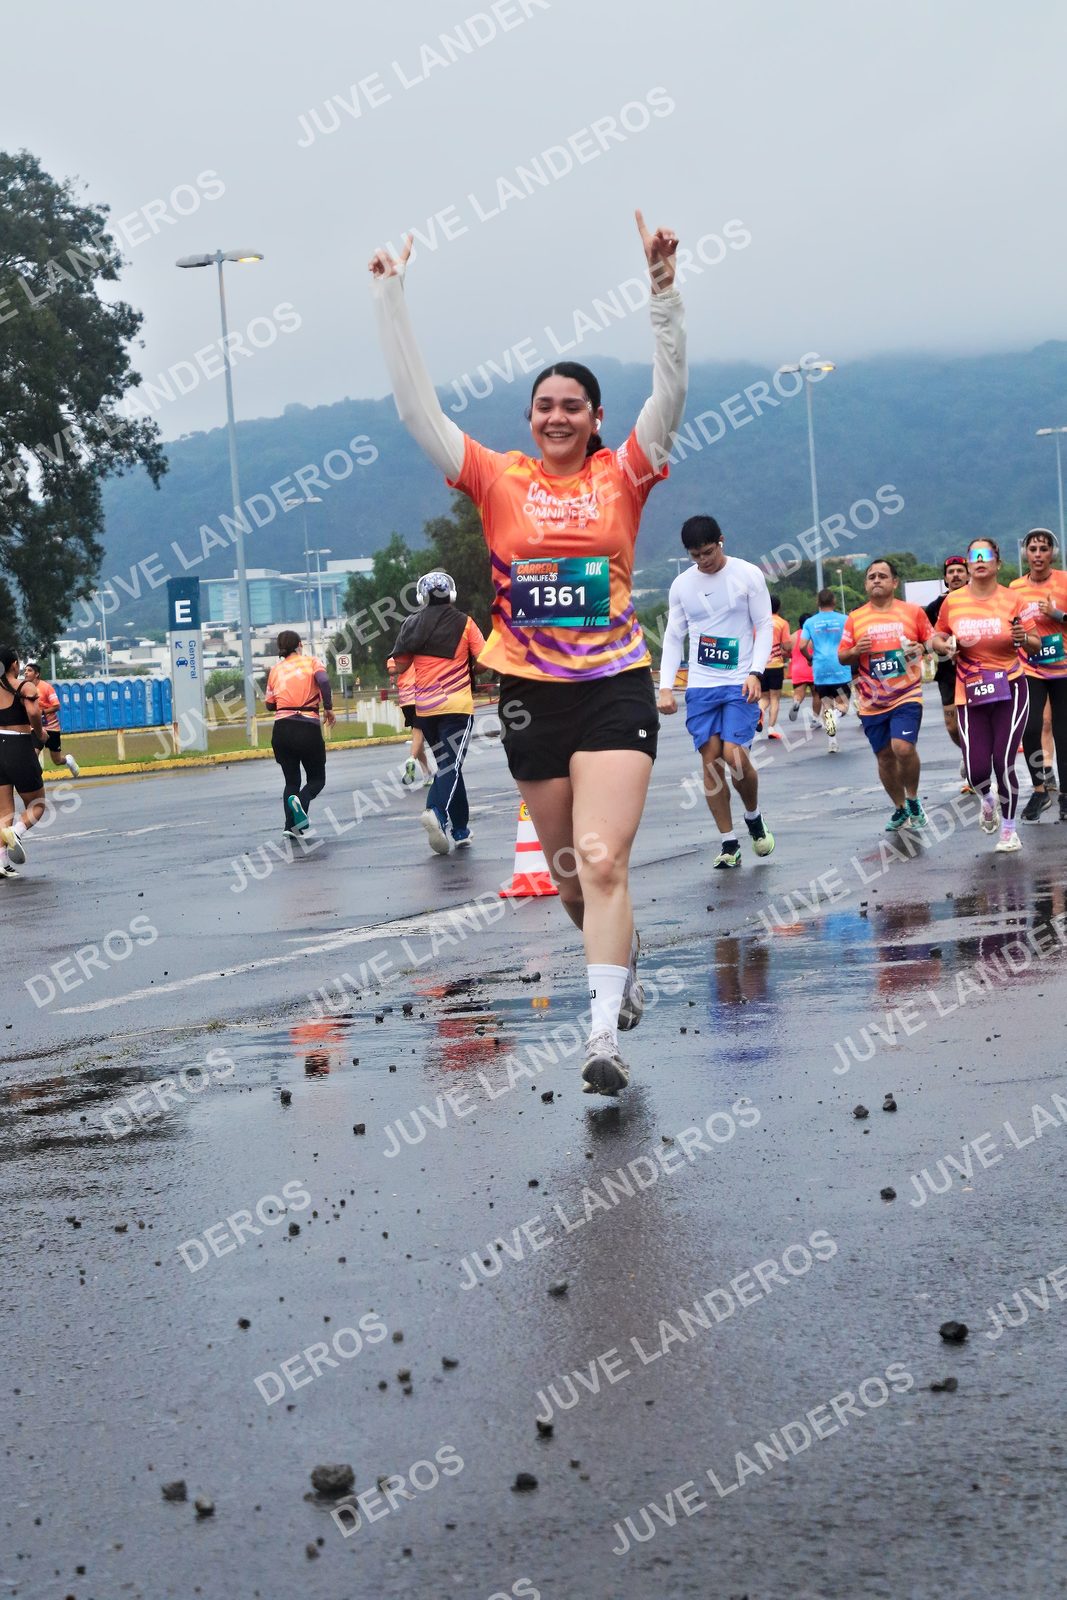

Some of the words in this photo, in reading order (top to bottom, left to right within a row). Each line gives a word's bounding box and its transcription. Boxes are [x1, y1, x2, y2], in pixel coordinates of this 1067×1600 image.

[517, 563, 558, 575] CARRERA
[584, 561, 603, 576] 10K
[516, 574, 549, 582] OMNILIFE
[528, 586, 586, 606] 1361
[175, 600, 192, 623] E
[704, 648, 730, 660] 1216
[1033, 646, 1056, 657] 156
[188, 640, 198, 679] General
[875, 660, 899, 671] 1331
[974, 683, 995, 696] 458
